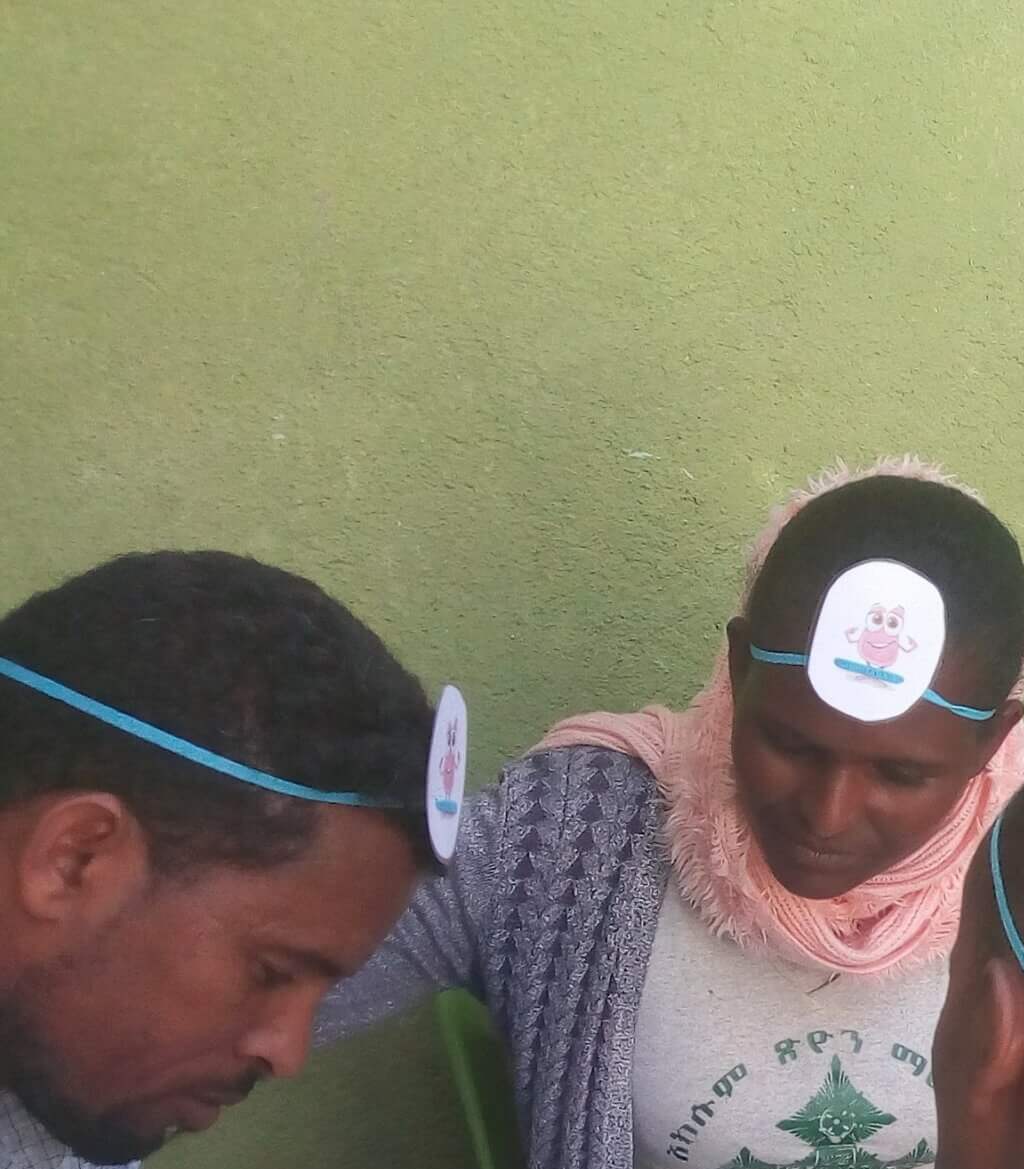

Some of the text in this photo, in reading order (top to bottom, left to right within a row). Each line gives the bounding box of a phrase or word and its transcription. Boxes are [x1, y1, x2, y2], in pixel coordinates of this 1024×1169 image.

[667, 1030, 935, 1162] አክሱም ጽዮን ማ
